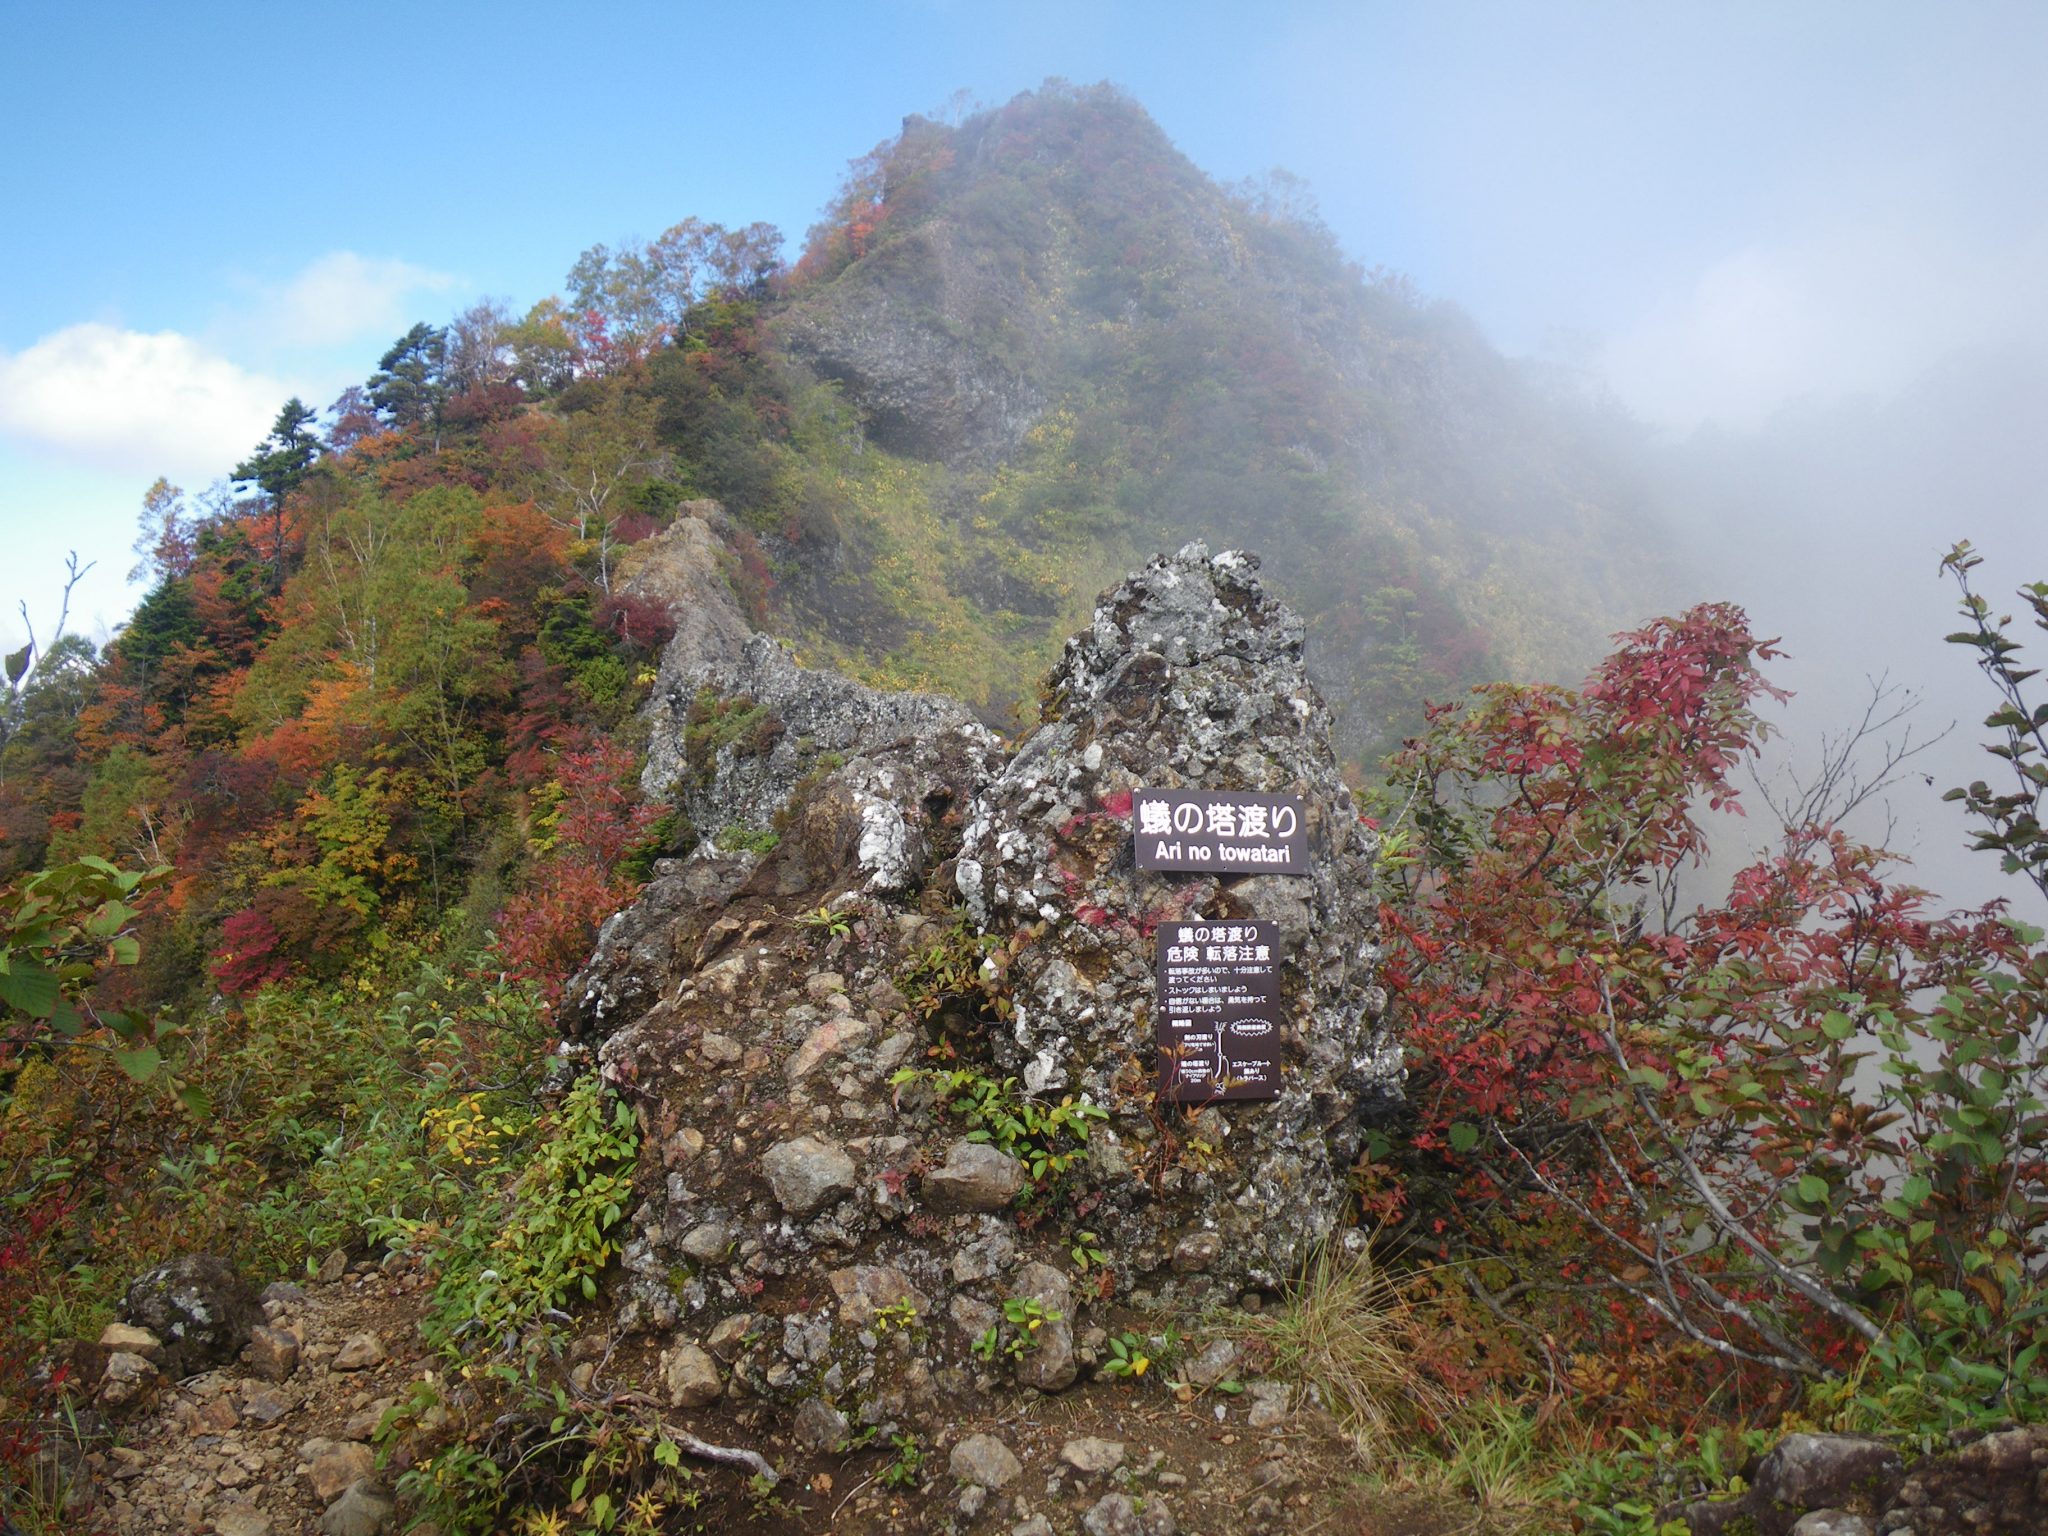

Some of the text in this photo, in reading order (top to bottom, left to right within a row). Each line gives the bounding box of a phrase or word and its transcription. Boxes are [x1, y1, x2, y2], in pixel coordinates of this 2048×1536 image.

[1139, 799, 1297, 838] 蟻の塔渡り
[1155, 840, 1291, 863] Ari no towatari
[1177, 926, 1258, 943] 蟻の塔渡り
[1166, 945, 1270, 962] 危険 転落注意
